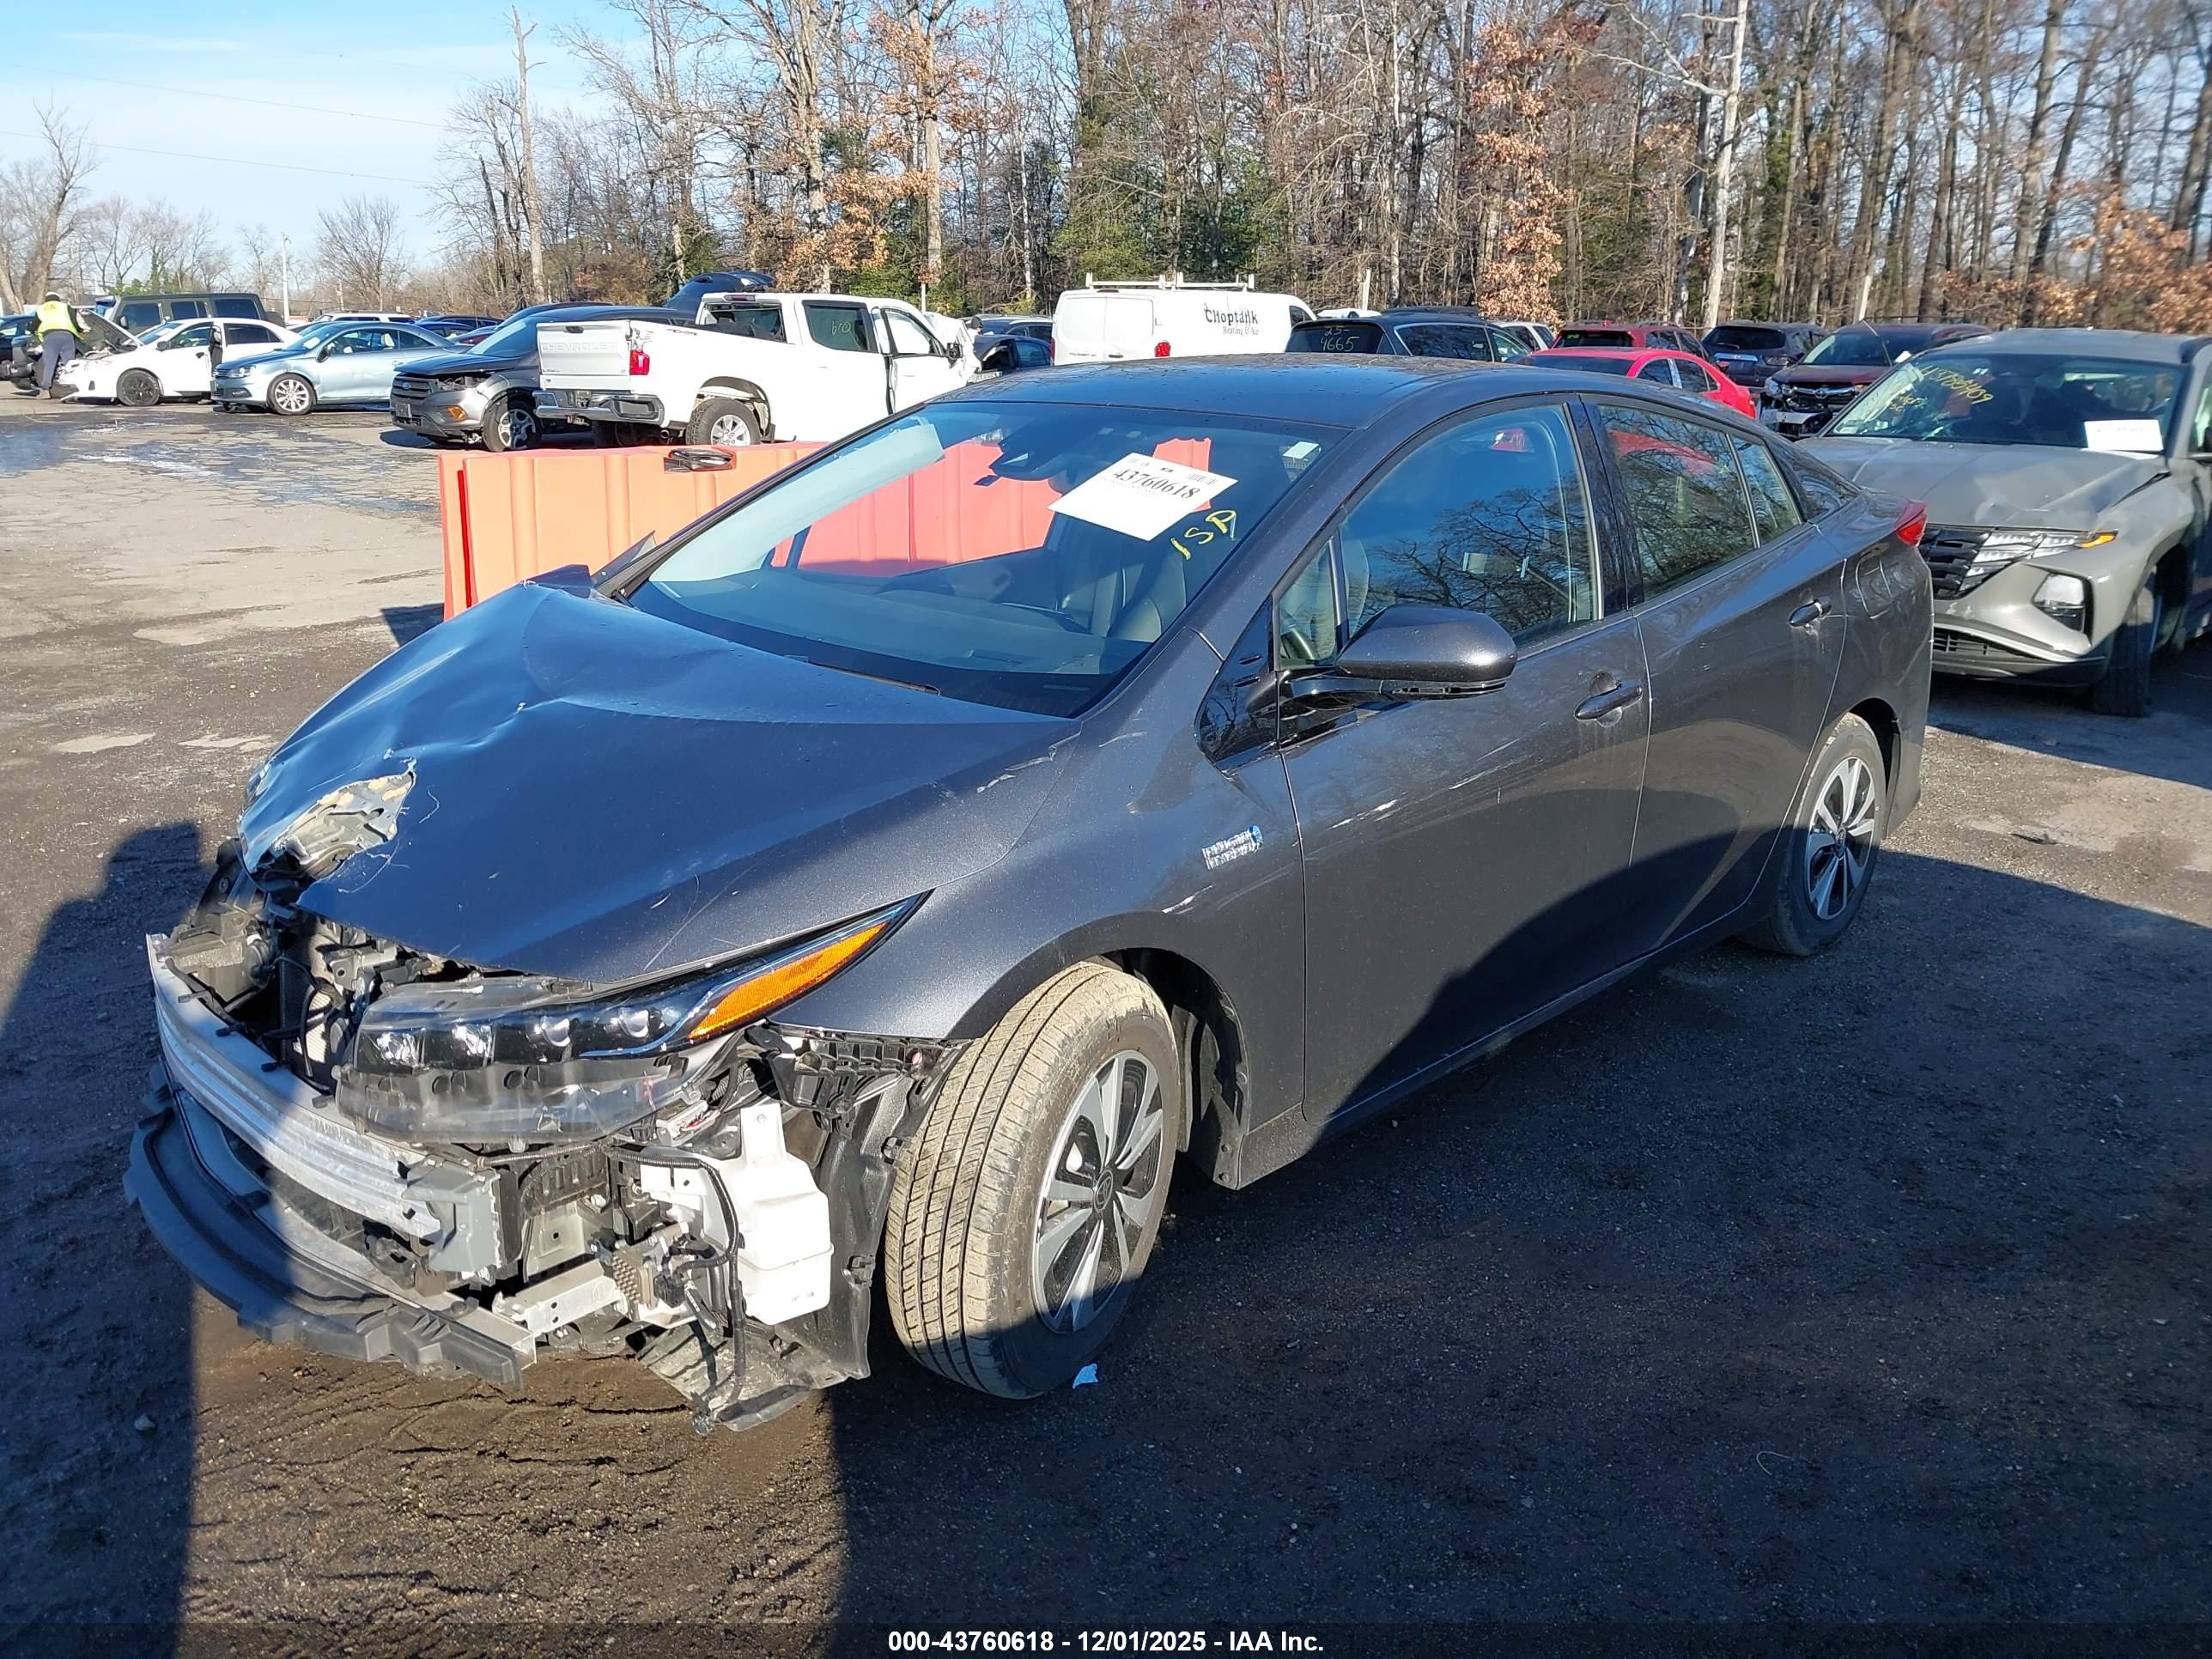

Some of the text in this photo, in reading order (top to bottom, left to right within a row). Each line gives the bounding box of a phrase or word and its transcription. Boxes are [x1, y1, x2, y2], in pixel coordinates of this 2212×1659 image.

[1204, 306, 1258, 326] Choptank
[542, 342, 617, 351] CHEVROLET
[1321, 336, 1360, 352] 4665
[1113, 468, 1201, 500] 43760618
